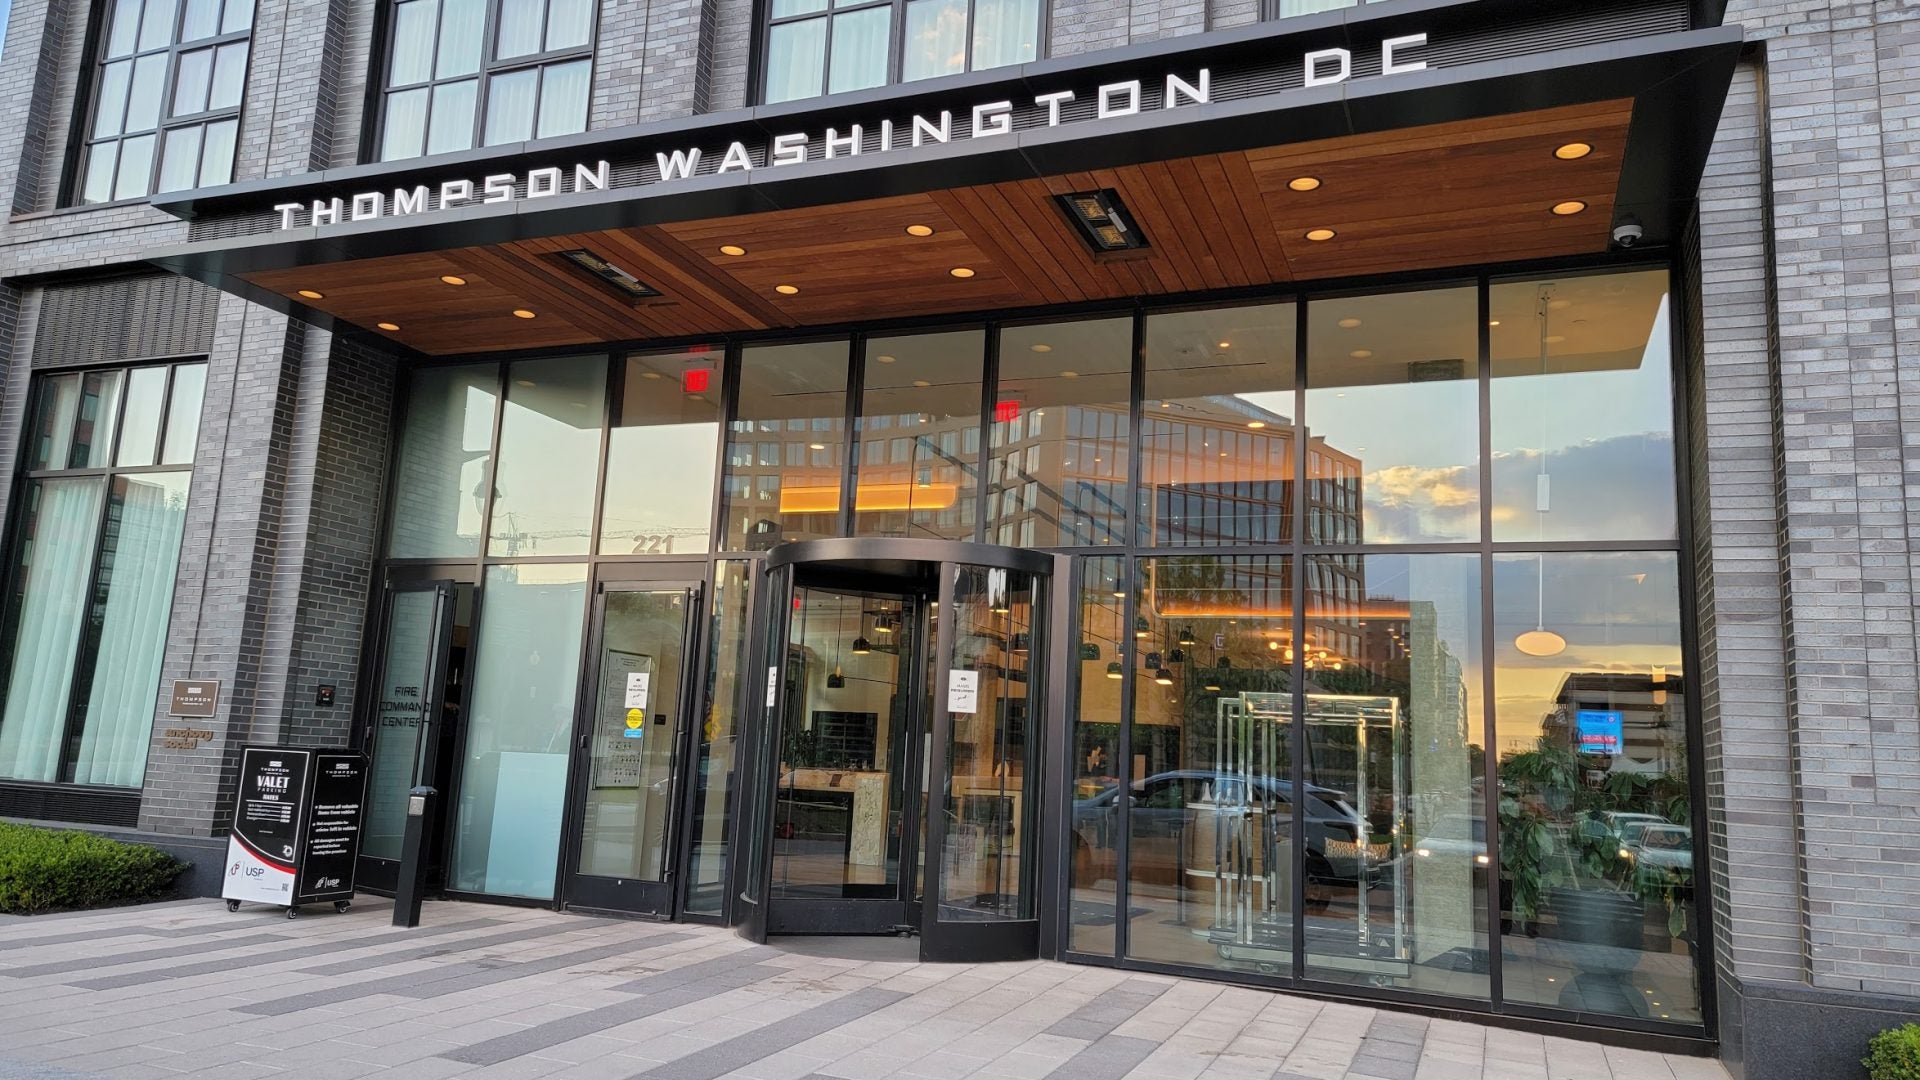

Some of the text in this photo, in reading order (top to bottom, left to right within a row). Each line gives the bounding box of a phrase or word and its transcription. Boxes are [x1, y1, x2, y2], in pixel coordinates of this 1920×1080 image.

[274, 33, 1427, 230] THOMPSON WASHINGTON DC
[632, 534, 675, 554] 221
[394, 686, 418, 697] FIRE
[257, 775, 290, 788] VALET
[245, 866, 265, 878] USP
[327, 878, 340, 886] USP
